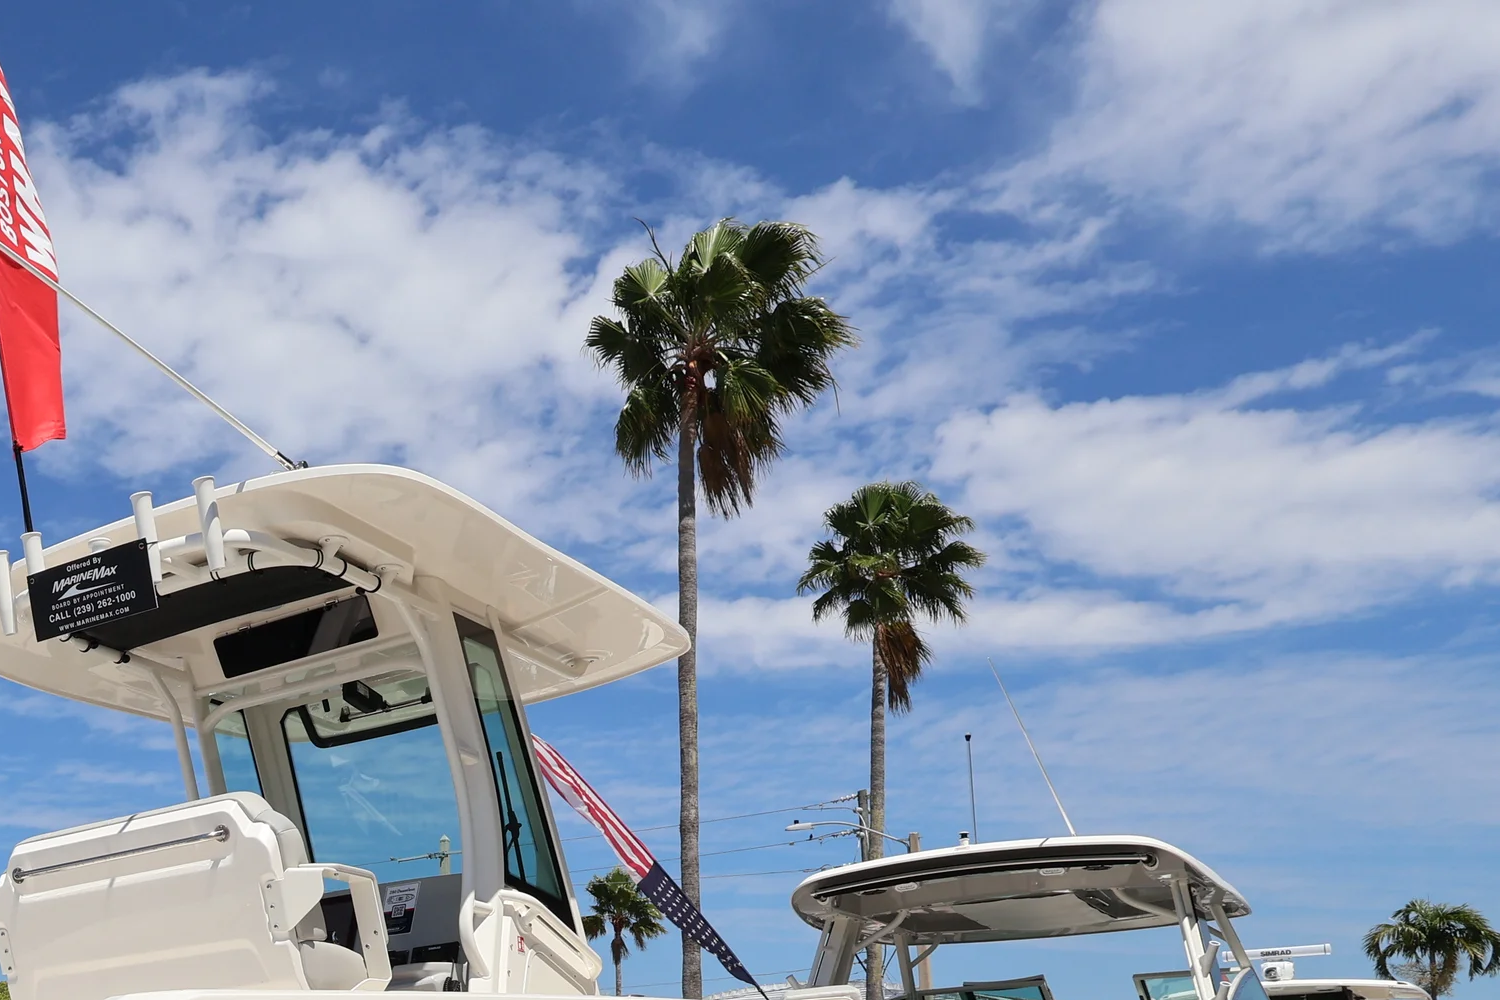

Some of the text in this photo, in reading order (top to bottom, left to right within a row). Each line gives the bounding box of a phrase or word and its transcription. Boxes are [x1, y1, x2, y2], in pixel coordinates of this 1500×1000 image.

[67, 556, 101, 572] Offered By
[49, 590, 136, 622] CALL (239) 262-1000
[52, 601, 71, 610] BOARD
[82, 584, 125, 601] APPOINTMENT
[59, 606, 130, 631] WWW.MARINEMAX.COM
